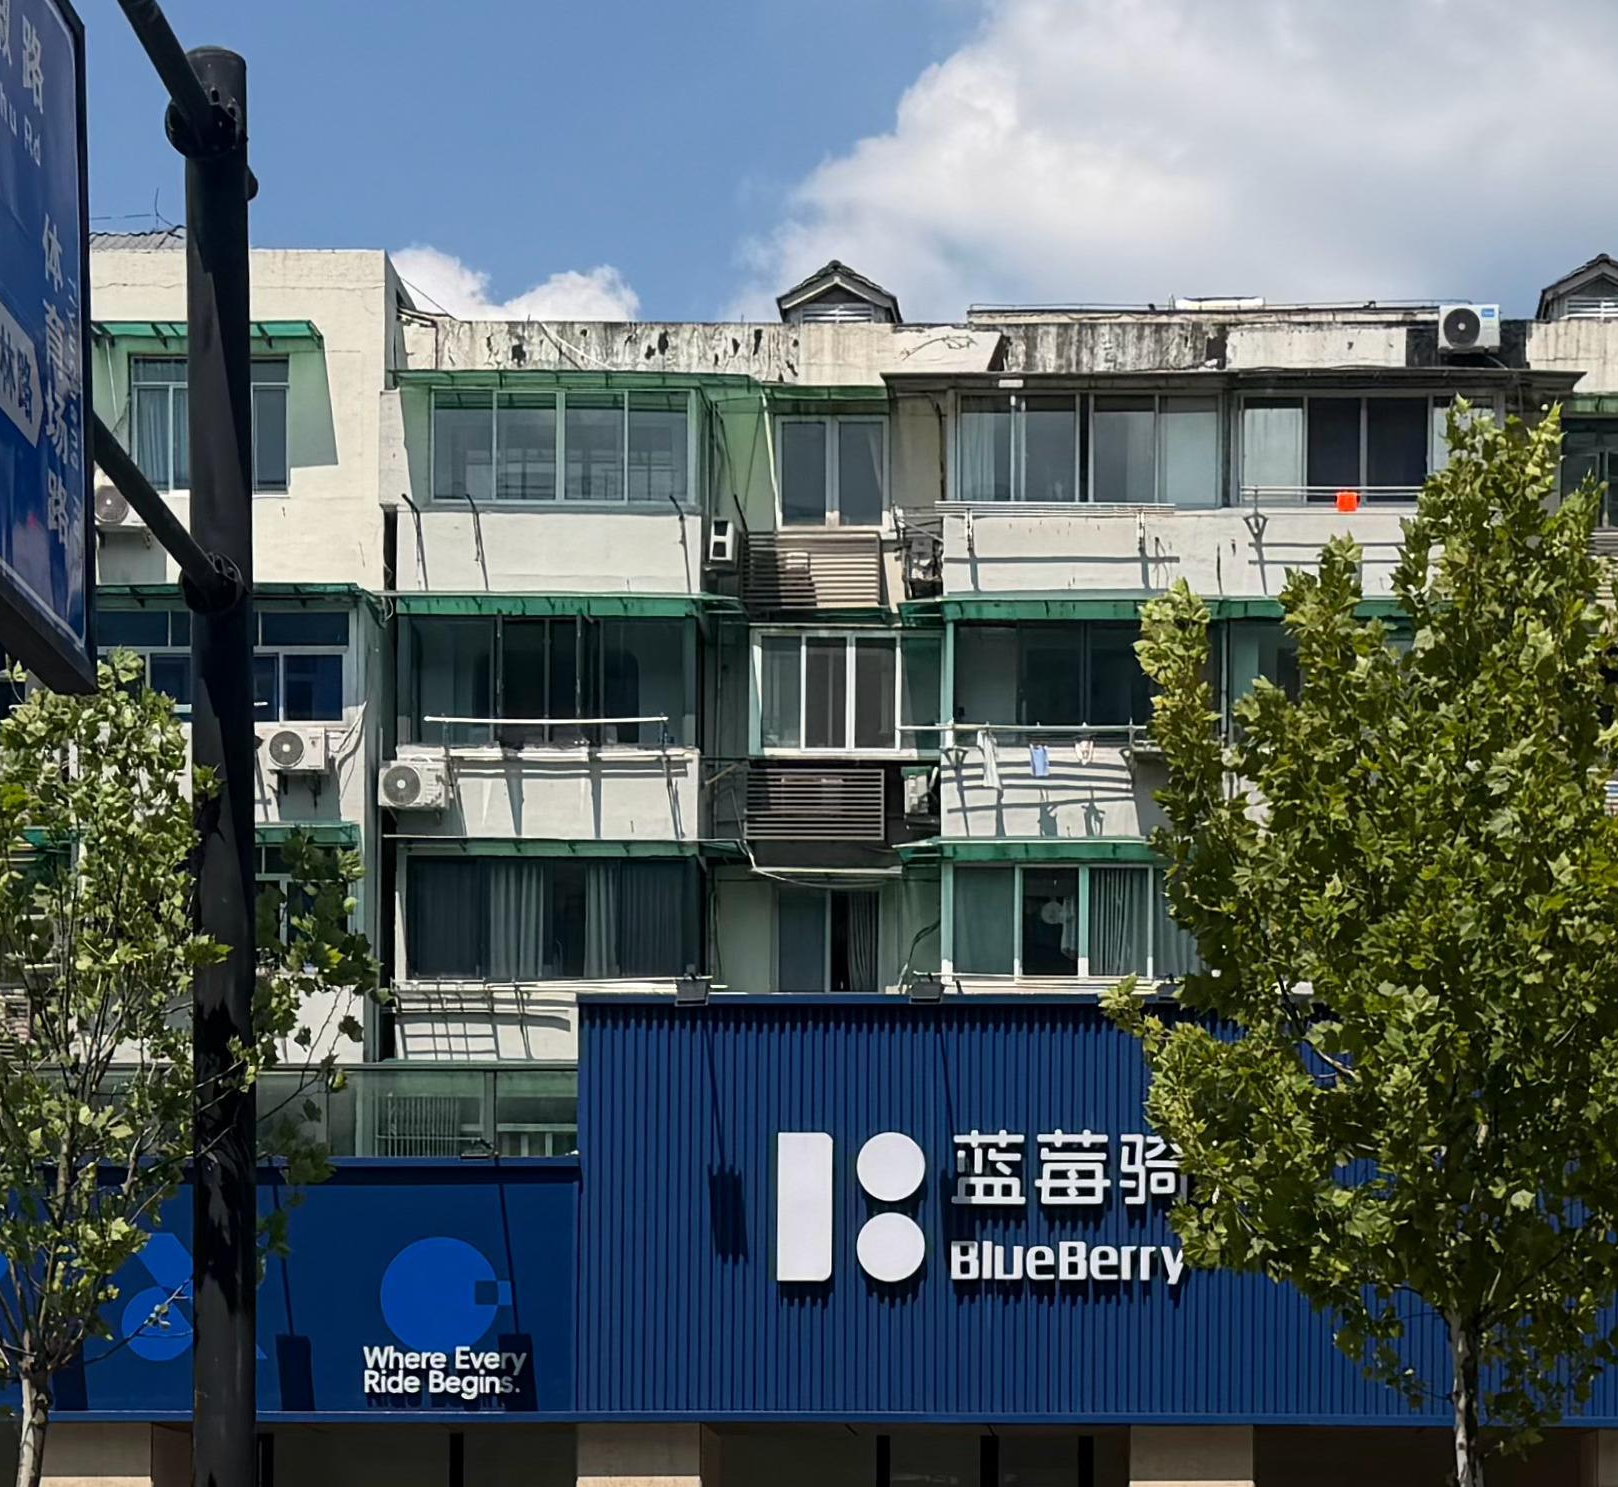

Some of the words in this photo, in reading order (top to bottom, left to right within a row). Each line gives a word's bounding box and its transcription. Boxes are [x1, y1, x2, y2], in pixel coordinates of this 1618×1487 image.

[24, 114, 42, 167] Rd
[43, 212, 70, 545] 体育场路
[951, 1241, 1183, 1285] BlueBerry
[363, 1345, 447, 1369] Where
[455, 1345, 527, 1376] Every
[364, 1369, 421, 1394] Ride
[428, 1369, 520, 1400] Begins.
